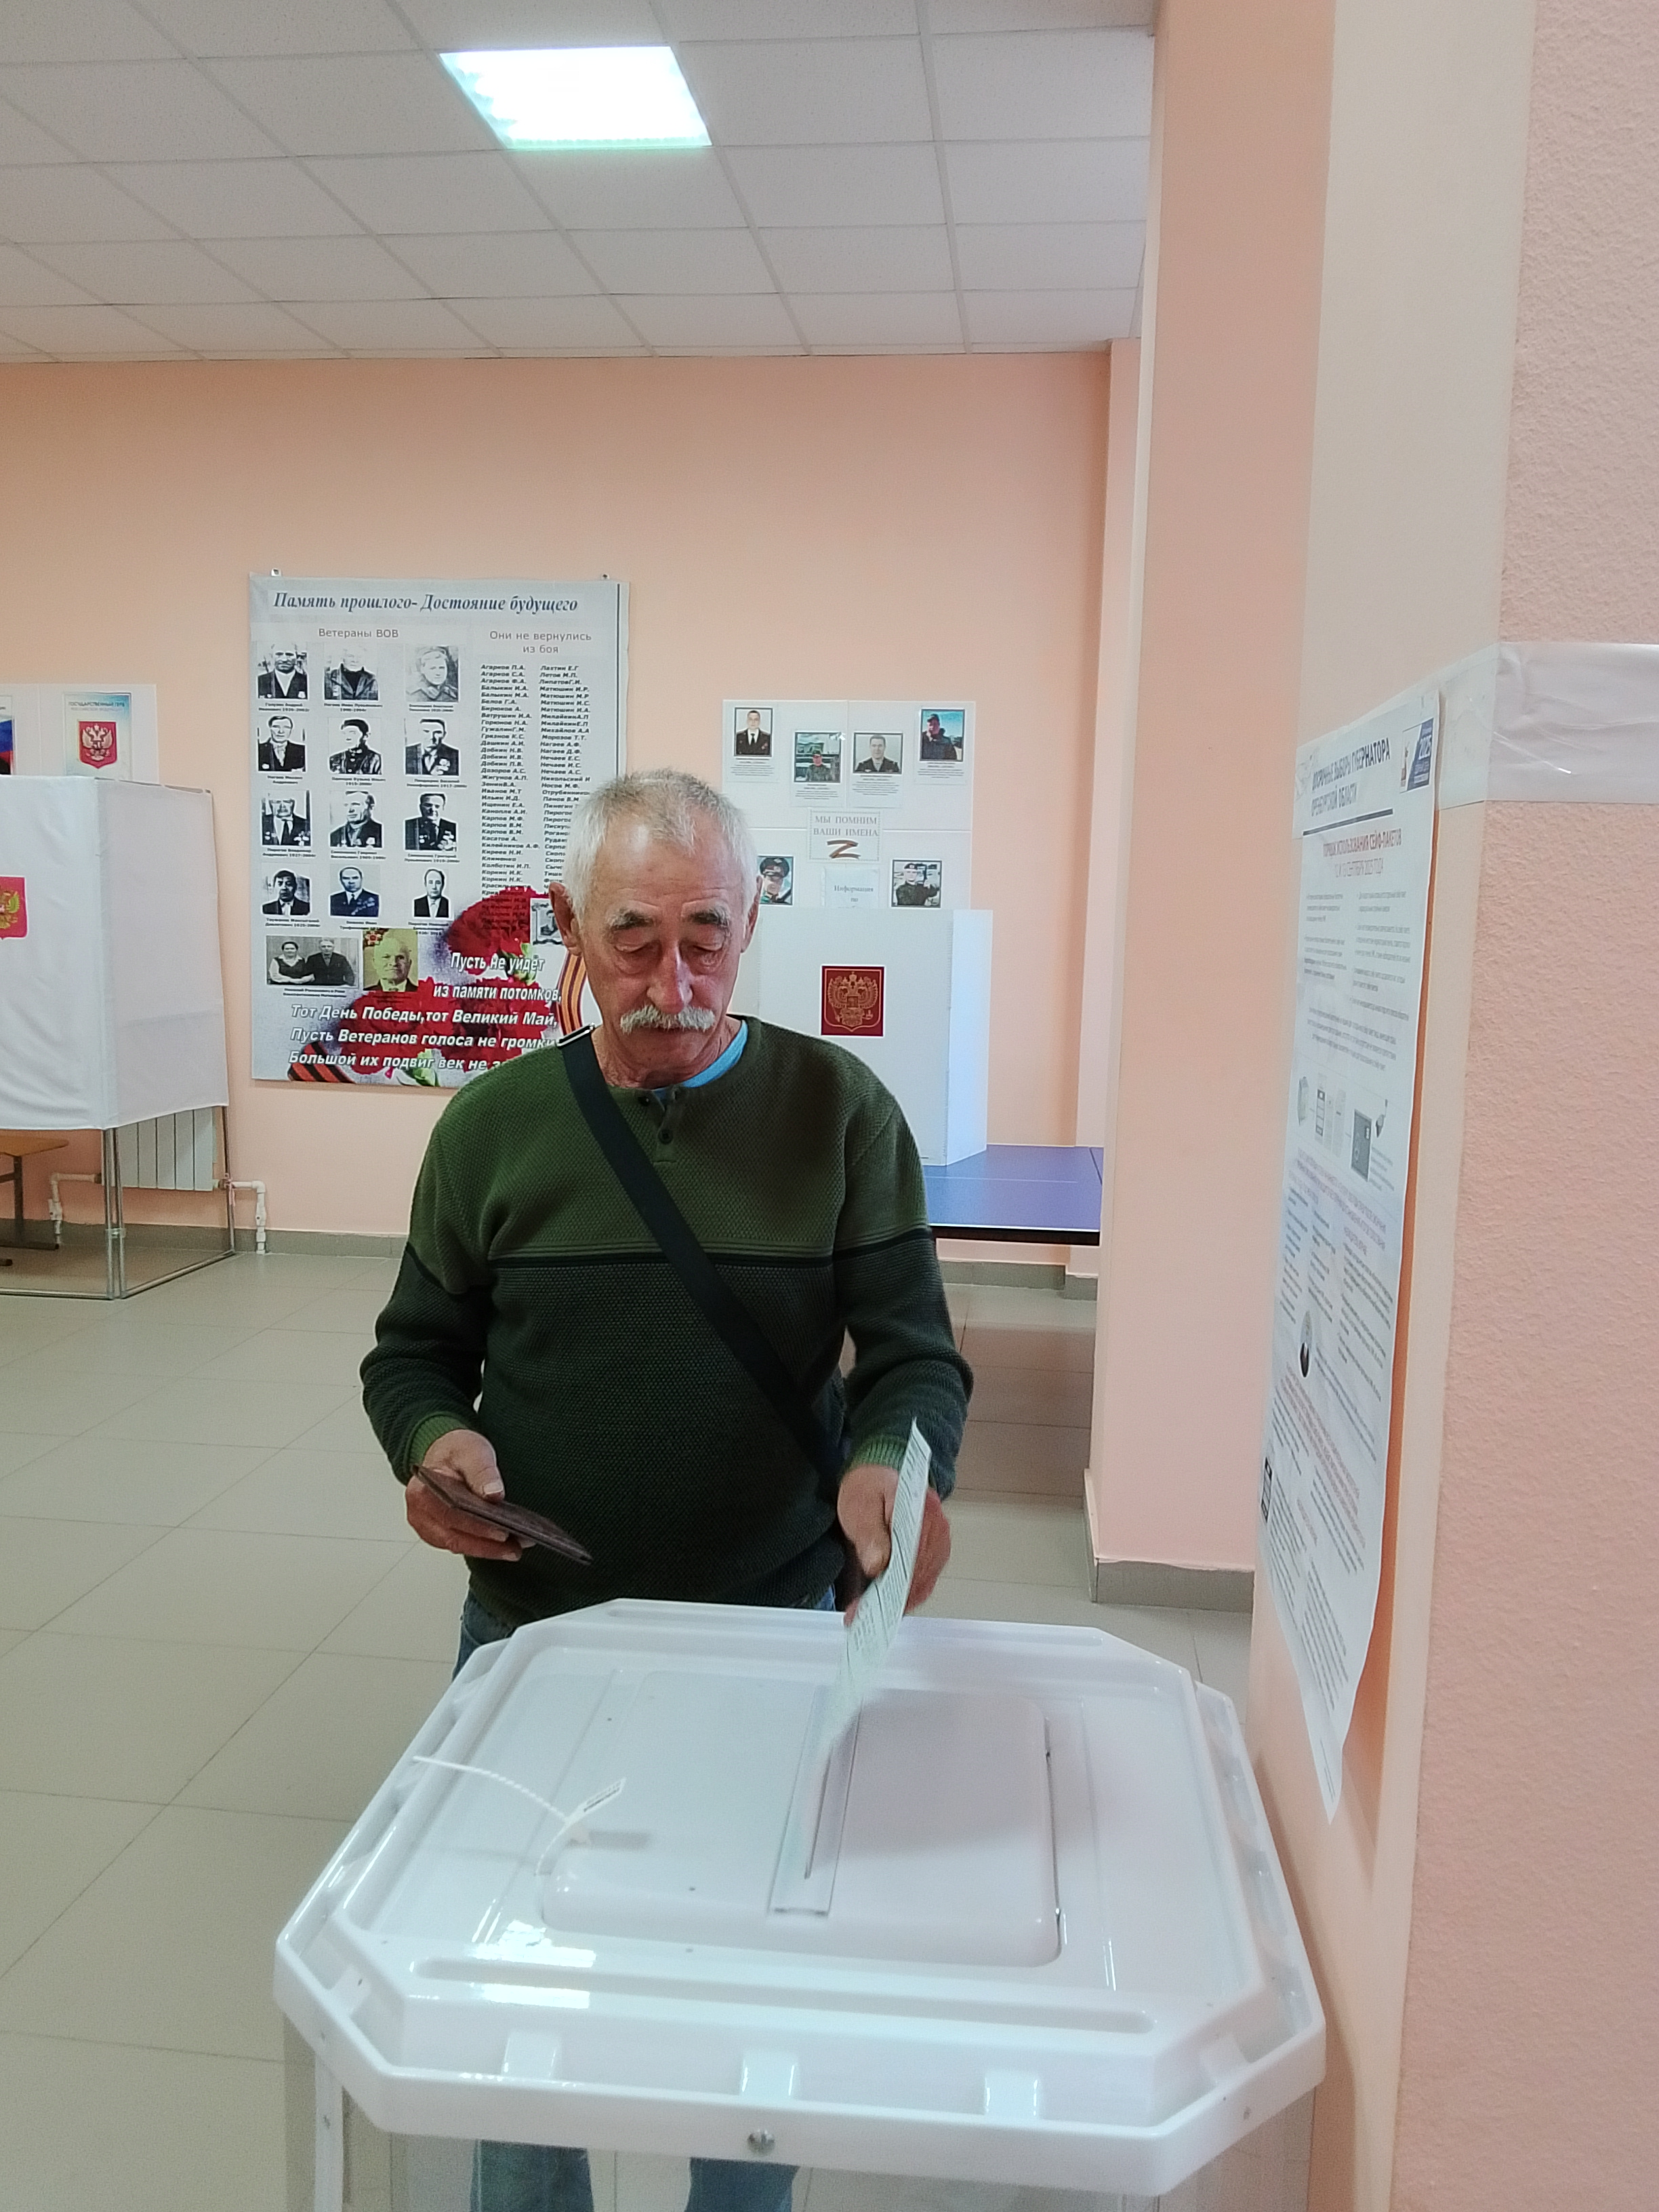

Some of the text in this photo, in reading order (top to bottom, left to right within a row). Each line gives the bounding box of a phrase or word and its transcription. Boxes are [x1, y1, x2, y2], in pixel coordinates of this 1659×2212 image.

[273, 592, 578, 615] Память прошлого- Достояние будущего
[319, 628, 398, 638] Ветераны ВОВ
[489, 631, 512, 640] Они
[533, 632, 592, 642] вернулись
[539, 644, 558, 653] боя
[836, 816, 877, 825] ПОМНИМ
[846, 828, 879, 837] ИМЕНА
[827, 839, 861, 859] Z
[451, 952, 487, 972] Пусть
[489, 956, 507, 970] не
[433, 985, 562, 1002] из памяти потомков,
[291, 1004, 317, 1018] Тот
[319, 1005, 358, 1021] День
[452, 1009, 518, 1025] Великий
[523, 1011, 558, 1027] Май,
[290, 1027, 333, 1044] Пусть
[338, 1029, 417, 1046] Ветеранов
[421, 1035, 474, 1046] голоса
[477, 1036, 497, 1047] не
[289, 1051, 356, 1065] Большой
[360, 1056, 378, 1066] их
[383, 1057, 434, 1069] подвиг
[438, 1059, 465, 1069] век
[468, 1060, 487, 1070] не
